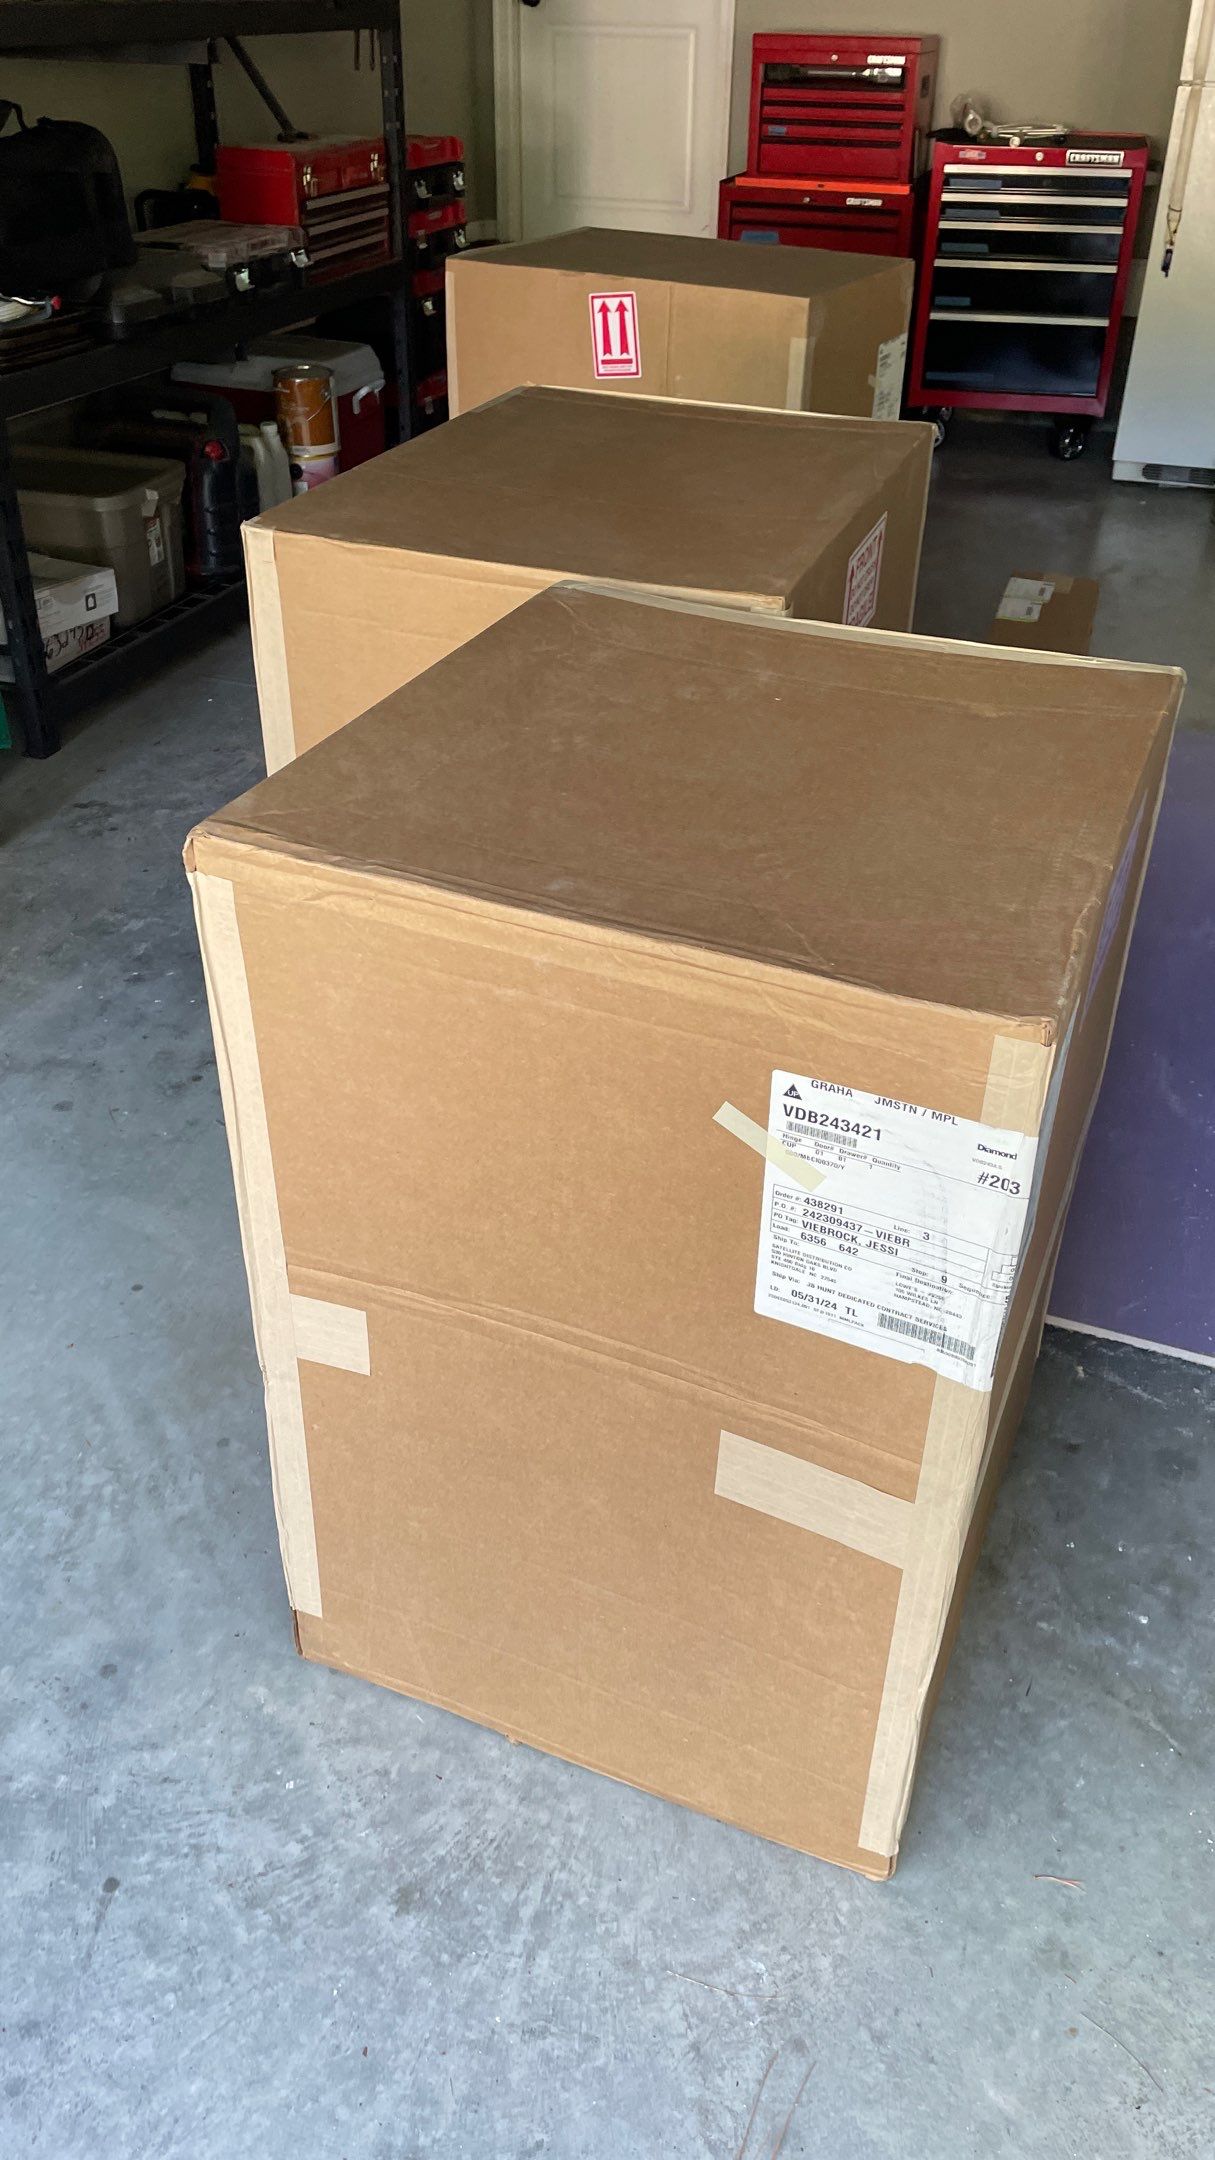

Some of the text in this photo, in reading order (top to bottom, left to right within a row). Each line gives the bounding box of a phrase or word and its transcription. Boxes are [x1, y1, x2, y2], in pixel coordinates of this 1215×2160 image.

[787, 1089, 799, 1097] UP
[811, 1080, 853, 1097] GRAHA
[874, 1096, 917, 1114] JMSTN
[931, 1111, 959, 1126] MPL
[783, 1103, 881, 1140] VDB243421
[872, 1157, 901, 1171] Quantity
[977, 1143, 1017, 1160] Diamond
[977, 1171, 1021, 1195] #203
[775, 1190, 793, 1200] Order
[803, 1196, 843, 1215] 438291
[922, 1231, 930, 1240] 3
[802, 1208, 863, 1232] 242309437
[875, 1230, 911, 1247] VIEBR
[773, 1234, 787, 1243] Ship
[801, 1220, 861, 1246] VIEBROCK,
[866, 1239, 899, 1256] JESSI
[800, 1231, 827, 1246] 6356
[838, 1243, 859, 1256] 642
[941, 1276, 948, 1284] 9
[791, 1289, 837, 1310] 05/31/24
[845, 1306, 859, 1317] TL
[817, 1284, 836, 1295] HUNT
[837, 1291, 876, 1308] DEDICATED
[876, 1304, 913, 1320] CONTRACT
[914, 1316, 948, 1331] SERVICES
